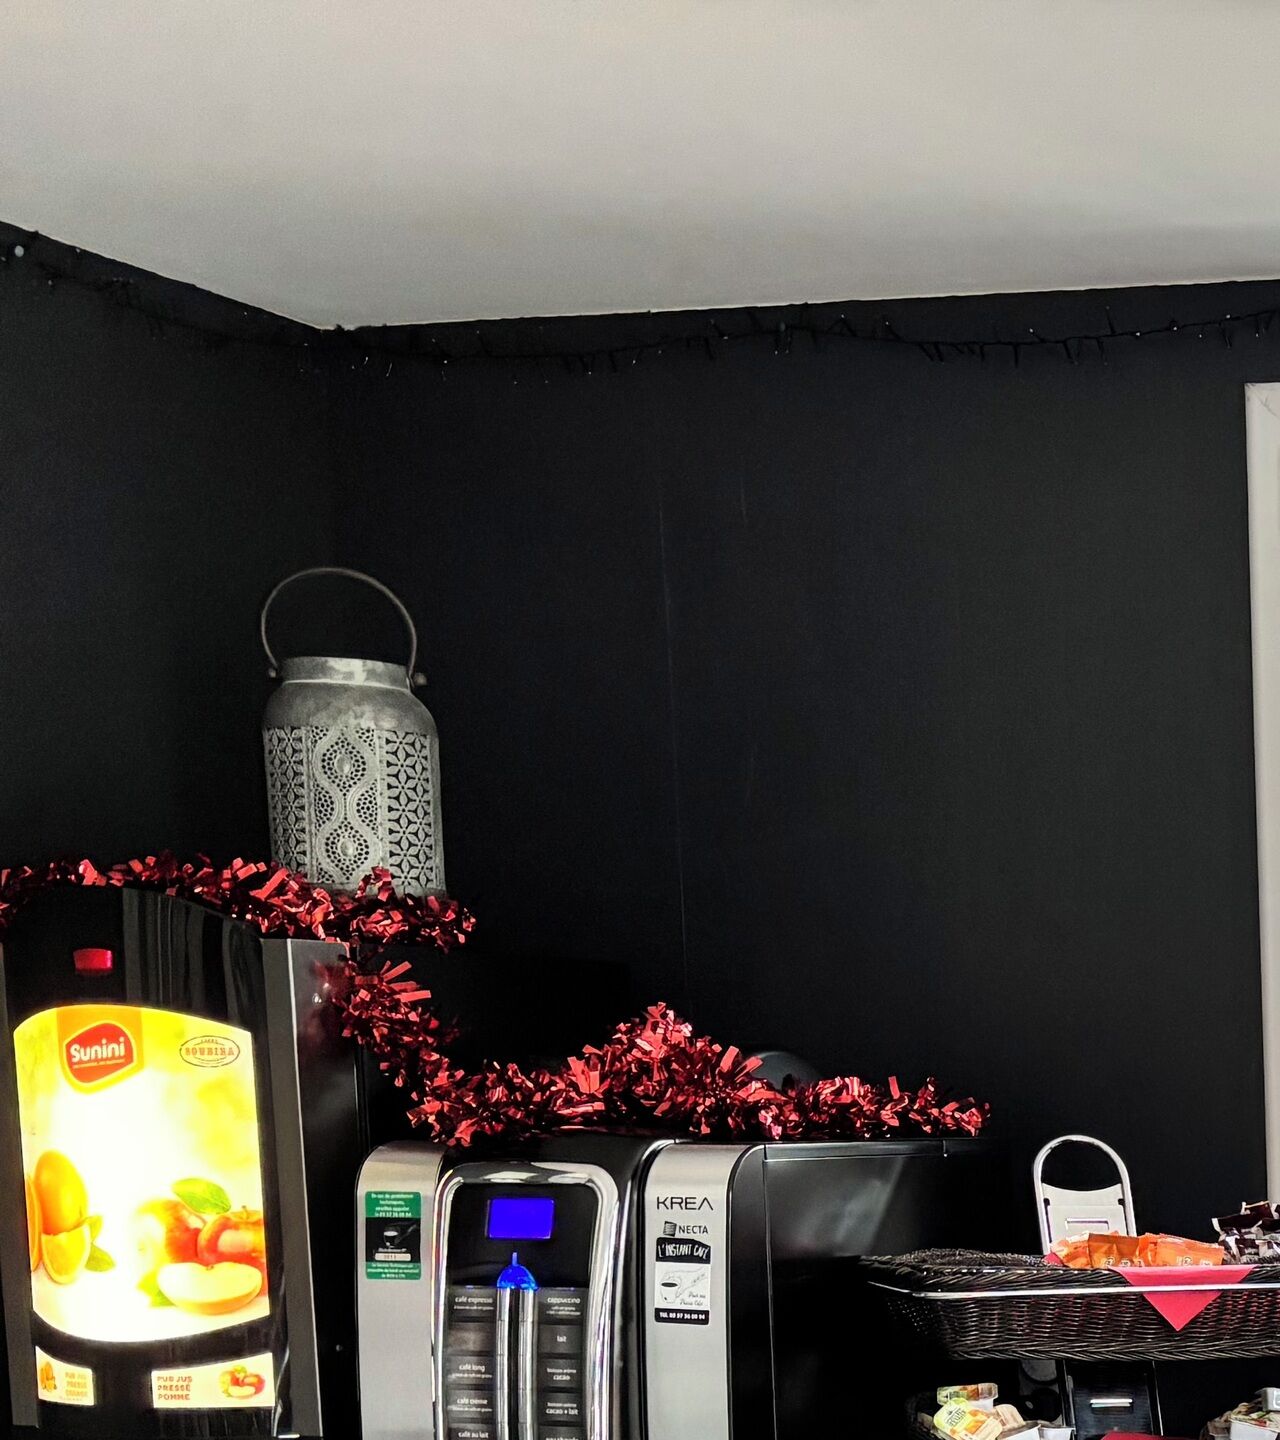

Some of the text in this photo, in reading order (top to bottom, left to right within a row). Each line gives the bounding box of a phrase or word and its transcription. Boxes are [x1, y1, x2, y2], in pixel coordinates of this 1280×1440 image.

[70, 1036, 125, 1063] Sunini
[656, 1196, 714, 1211] KREA
[678, 1225, 709, 1234] NECTA
